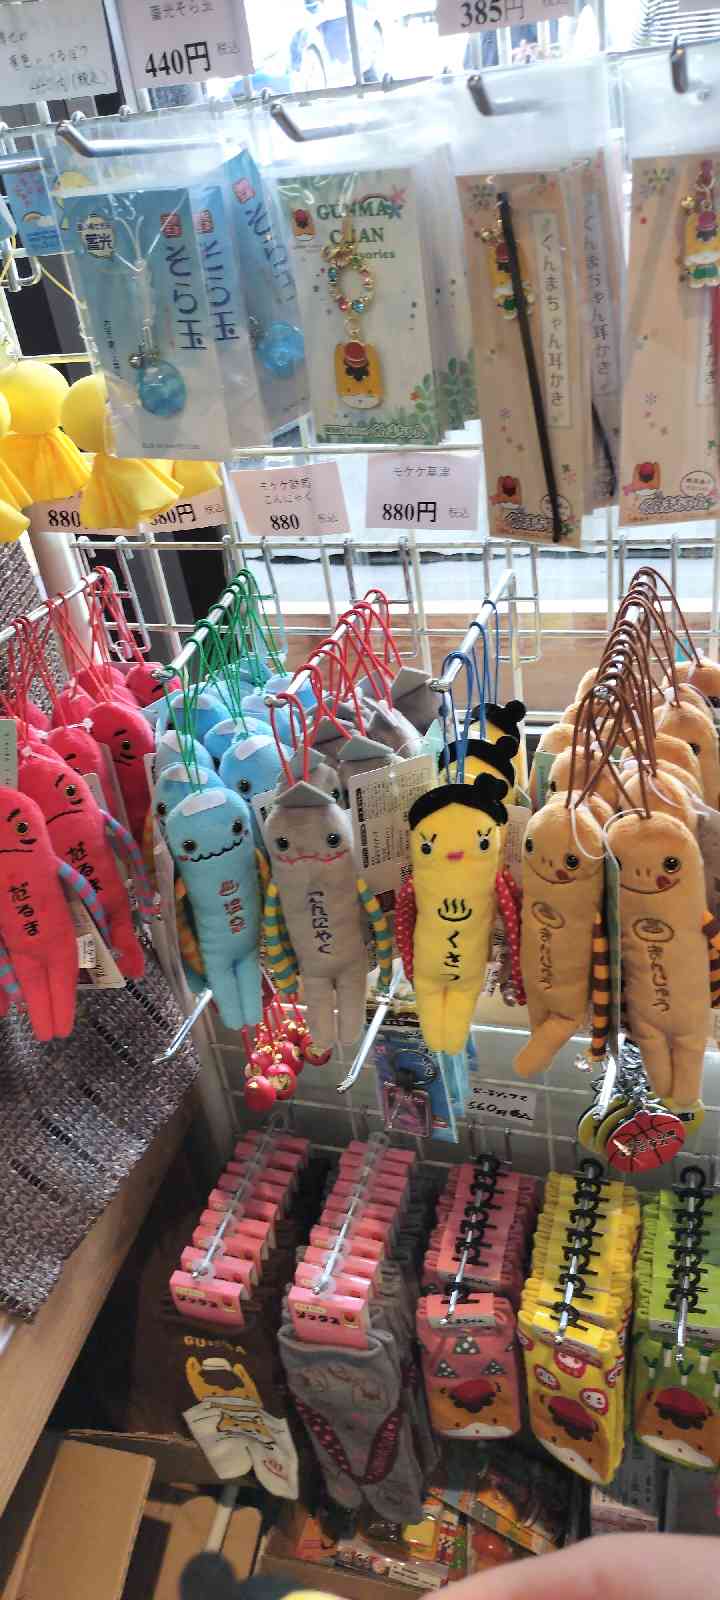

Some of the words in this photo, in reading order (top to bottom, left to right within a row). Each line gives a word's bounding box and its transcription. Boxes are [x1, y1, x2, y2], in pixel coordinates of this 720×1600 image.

[144, 41, 211, 77] 440円
[329, 226, 385, 245] CAN
[48, 509, 81, 528] 880
[270, 513, 300, 532] 880
[382, 501, 437, 523] 880円
[8, 881, 38, 937] だるま
[440, 929, 462, 982] くさつ
